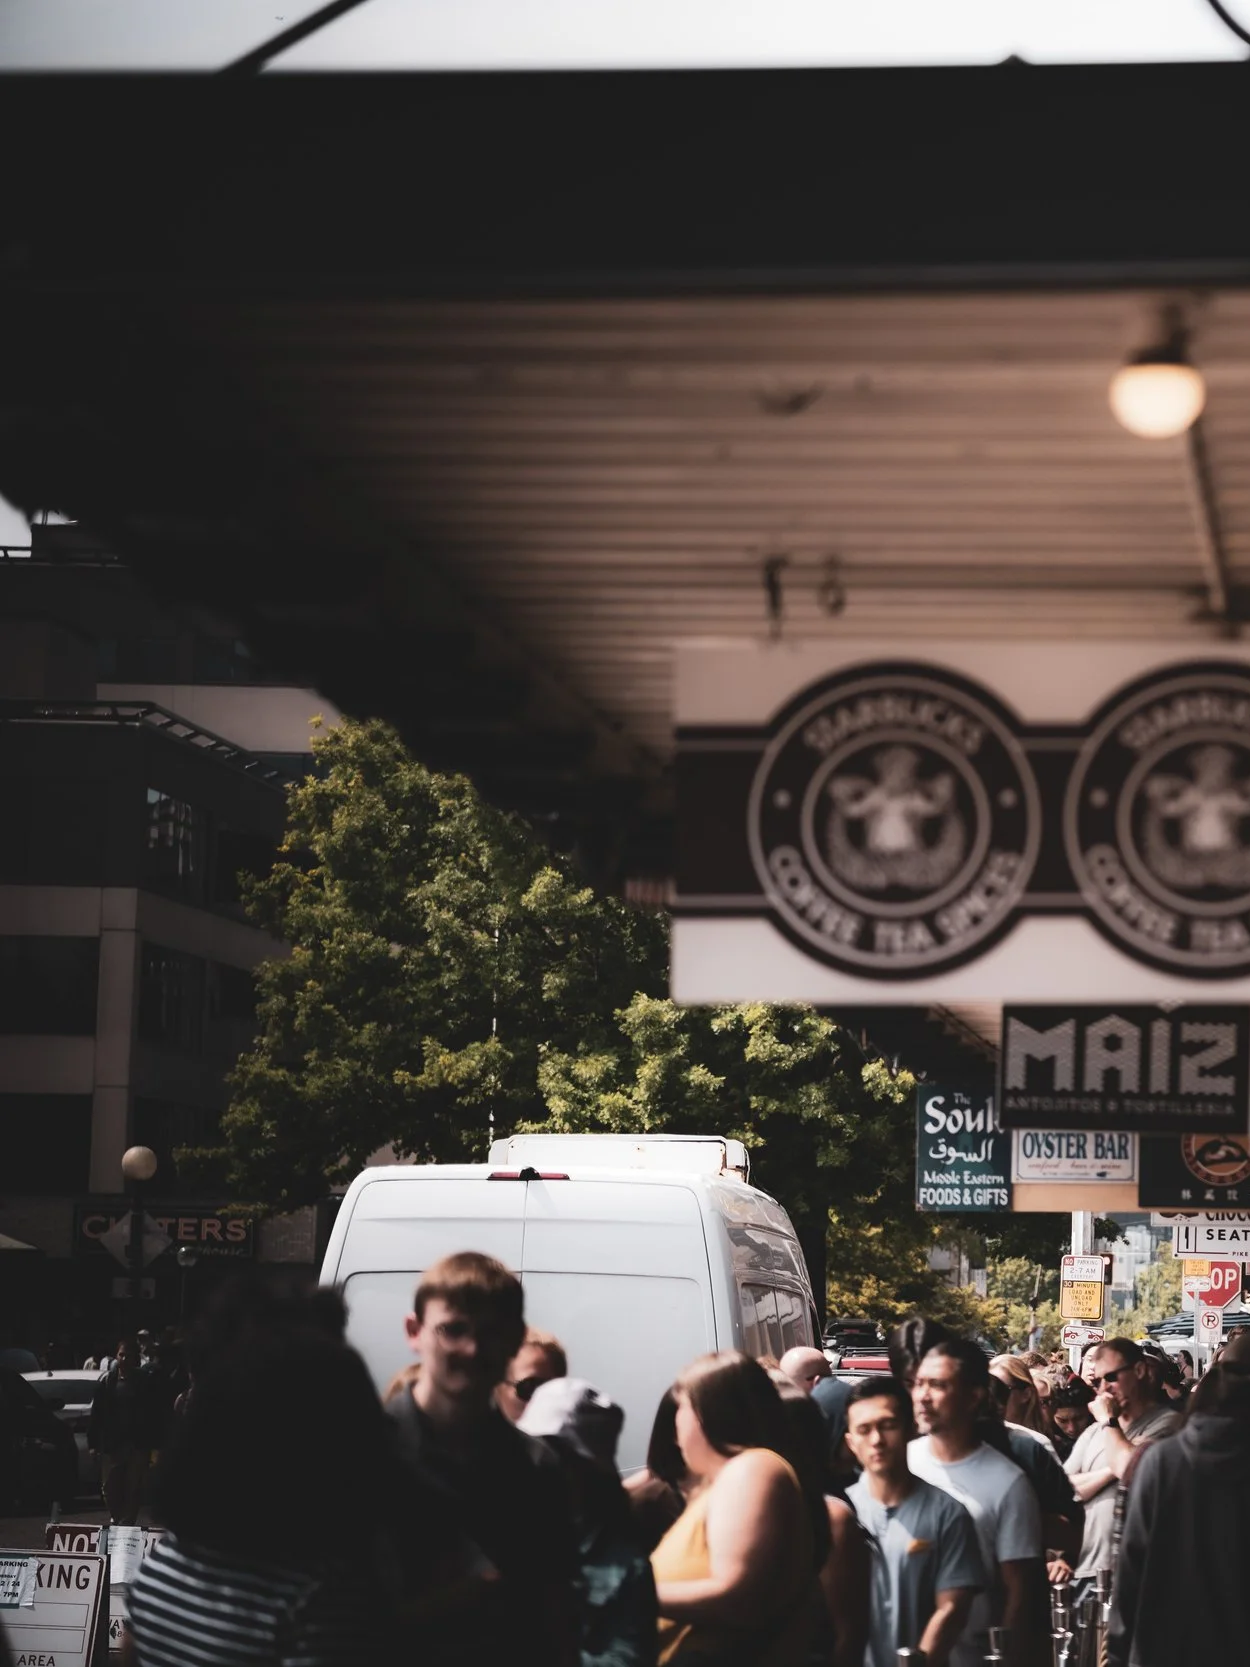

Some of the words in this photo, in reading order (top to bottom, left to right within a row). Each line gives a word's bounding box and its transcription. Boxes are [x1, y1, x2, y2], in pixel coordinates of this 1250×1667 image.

[953, 1092, 971, 1105] The
[929, 1138, 995, 1165] السوق
[1022, 1132, 1087, 1159] OYSTER
[1094, 1132, 1129, 1160] BAR
[963, 1170, 1004, 1184] Eastern
[920, 1188, 961, 1205] FOODS
[962, 1188, 971, 1205] &
[973, 1188, 1008, 1206] GIFTS
[1210, 1268, 1237, 1290] OP
[36, 1563, 91, 1590] KING
[17, 1655, 55, 1666] AREA
